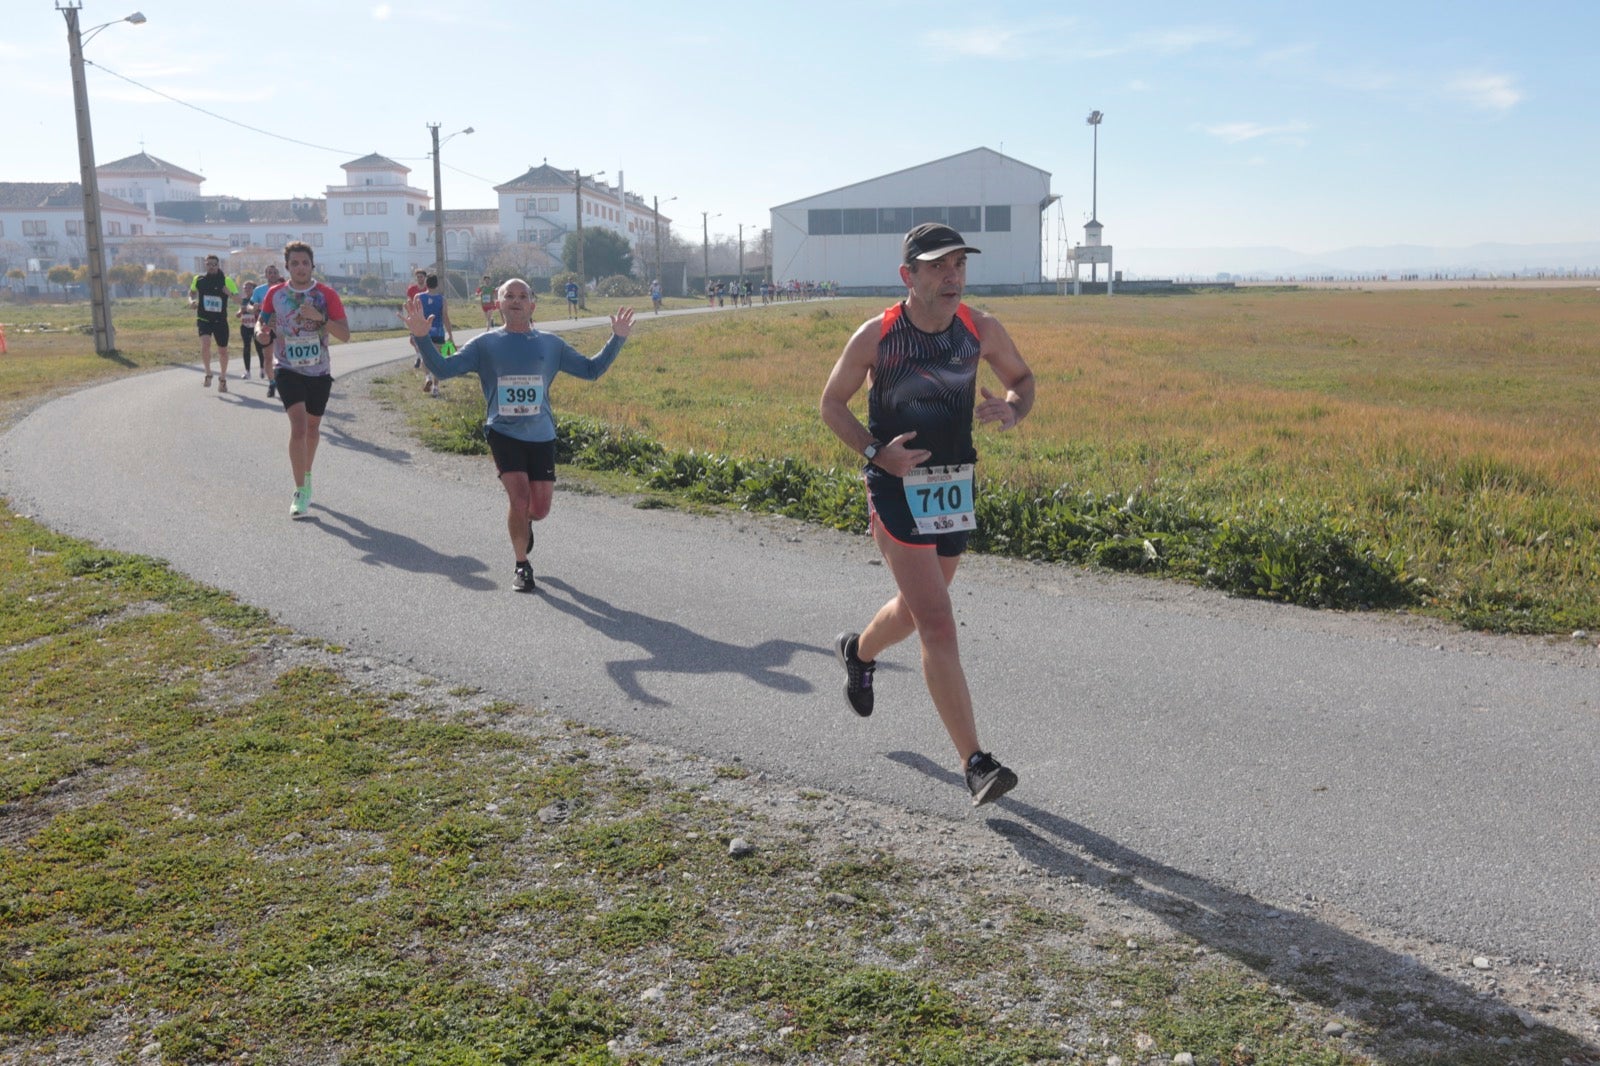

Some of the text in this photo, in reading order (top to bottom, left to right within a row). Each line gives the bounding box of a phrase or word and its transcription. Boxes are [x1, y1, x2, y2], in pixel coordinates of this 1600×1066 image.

[288, 344, 319, 358] 1070
[506, 388, 537, 403] 399
[917, 485, 962, 513] 710
